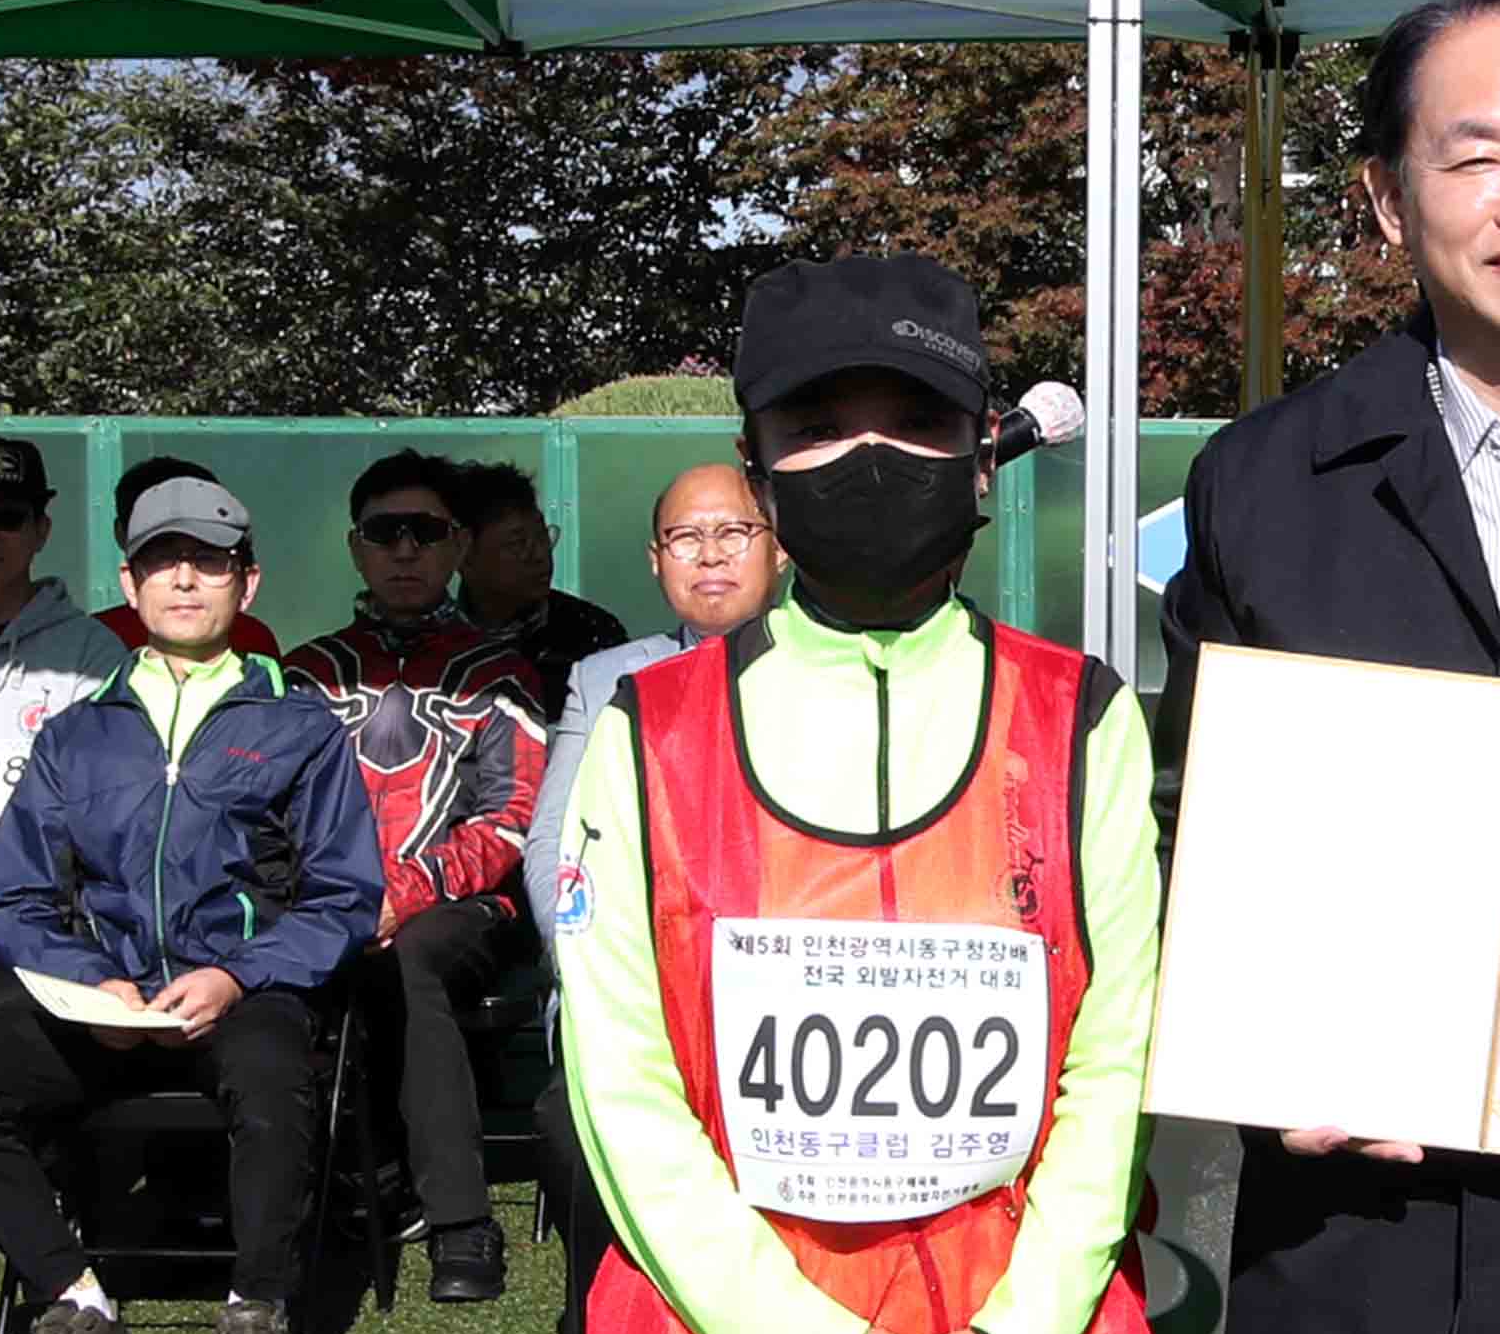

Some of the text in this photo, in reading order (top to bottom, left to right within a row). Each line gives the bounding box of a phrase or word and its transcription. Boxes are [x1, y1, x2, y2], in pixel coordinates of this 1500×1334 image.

[802, 933, 1029, 964] 인천광역시동구청장배
[803, 965, 1022, 990] 전국 외발자전거 대회
[738, 1013, 1020, 1119] 40202
[750, 1128, 1011, 1159] 인천동구클럽 김주영
